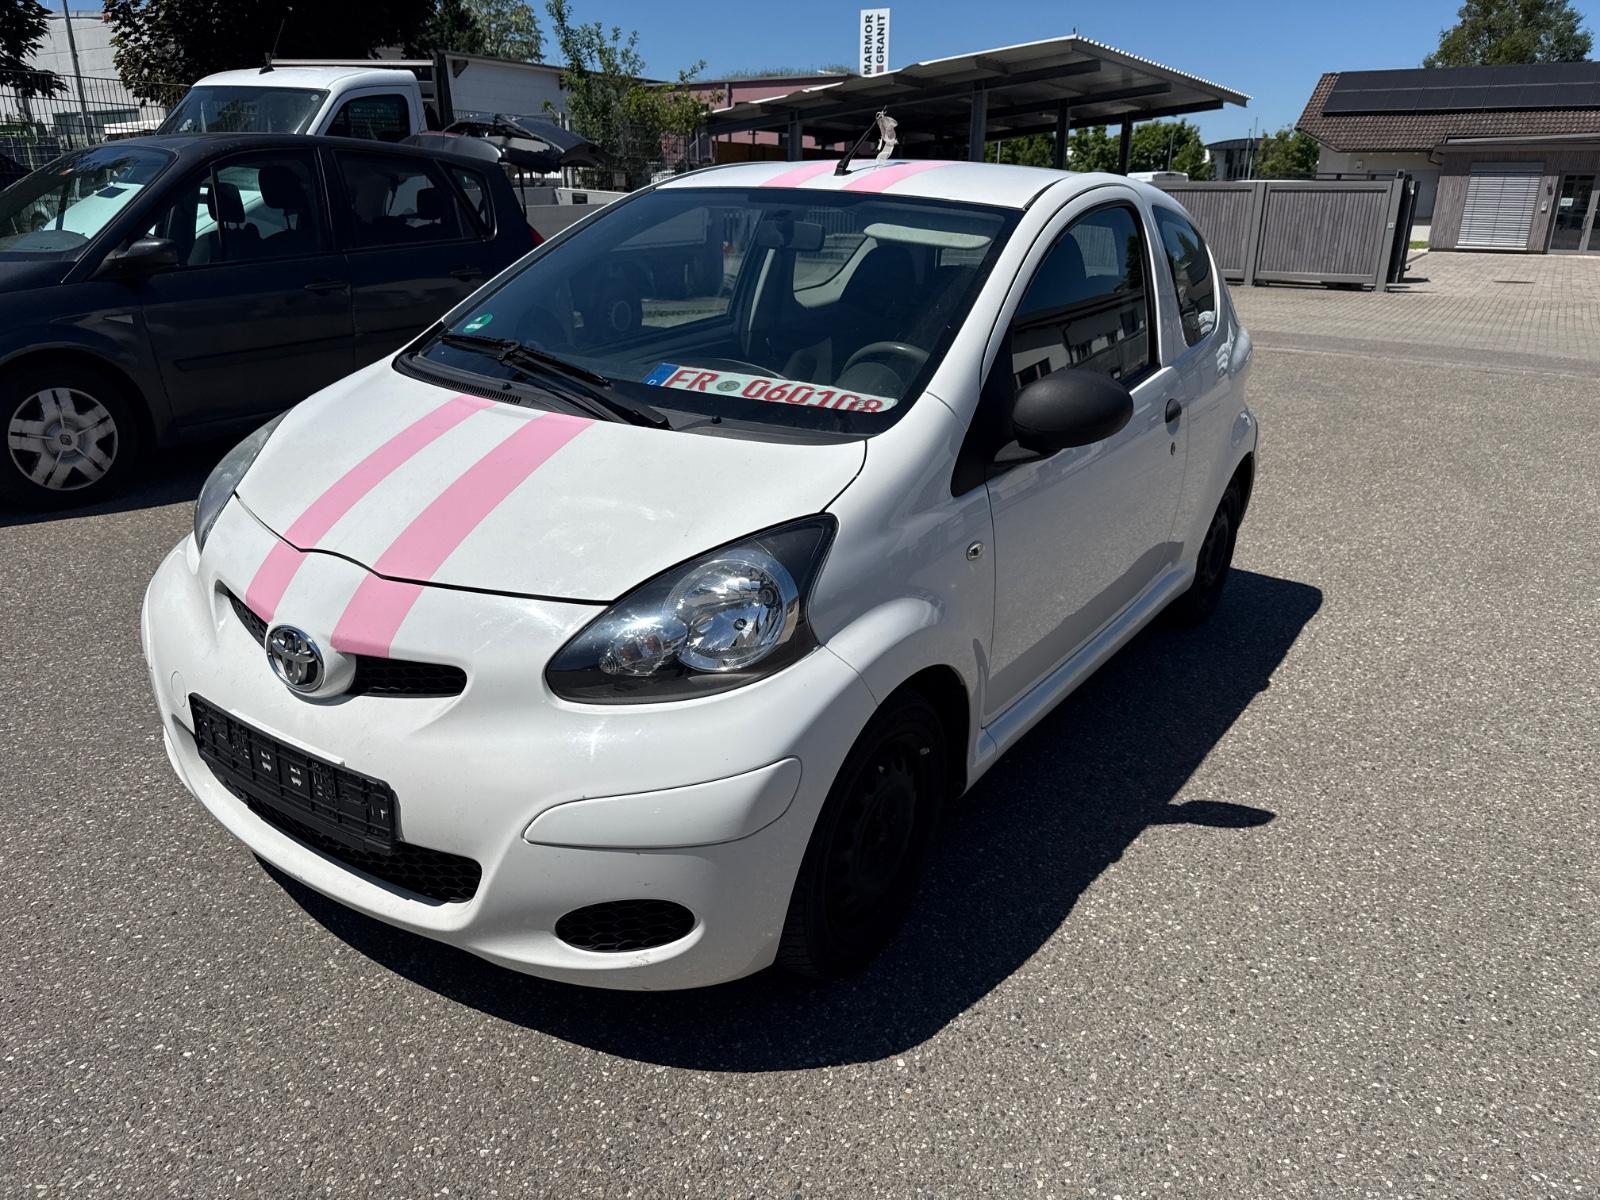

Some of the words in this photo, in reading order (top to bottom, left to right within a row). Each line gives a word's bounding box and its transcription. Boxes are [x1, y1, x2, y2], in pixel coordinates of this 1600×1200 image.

[864, 14, 873, 75] MARMOR
[876, 13, 885, 64] GRANIT
[663, 369, 719, 392] FR
[742, 379, 883, 413] 060108
